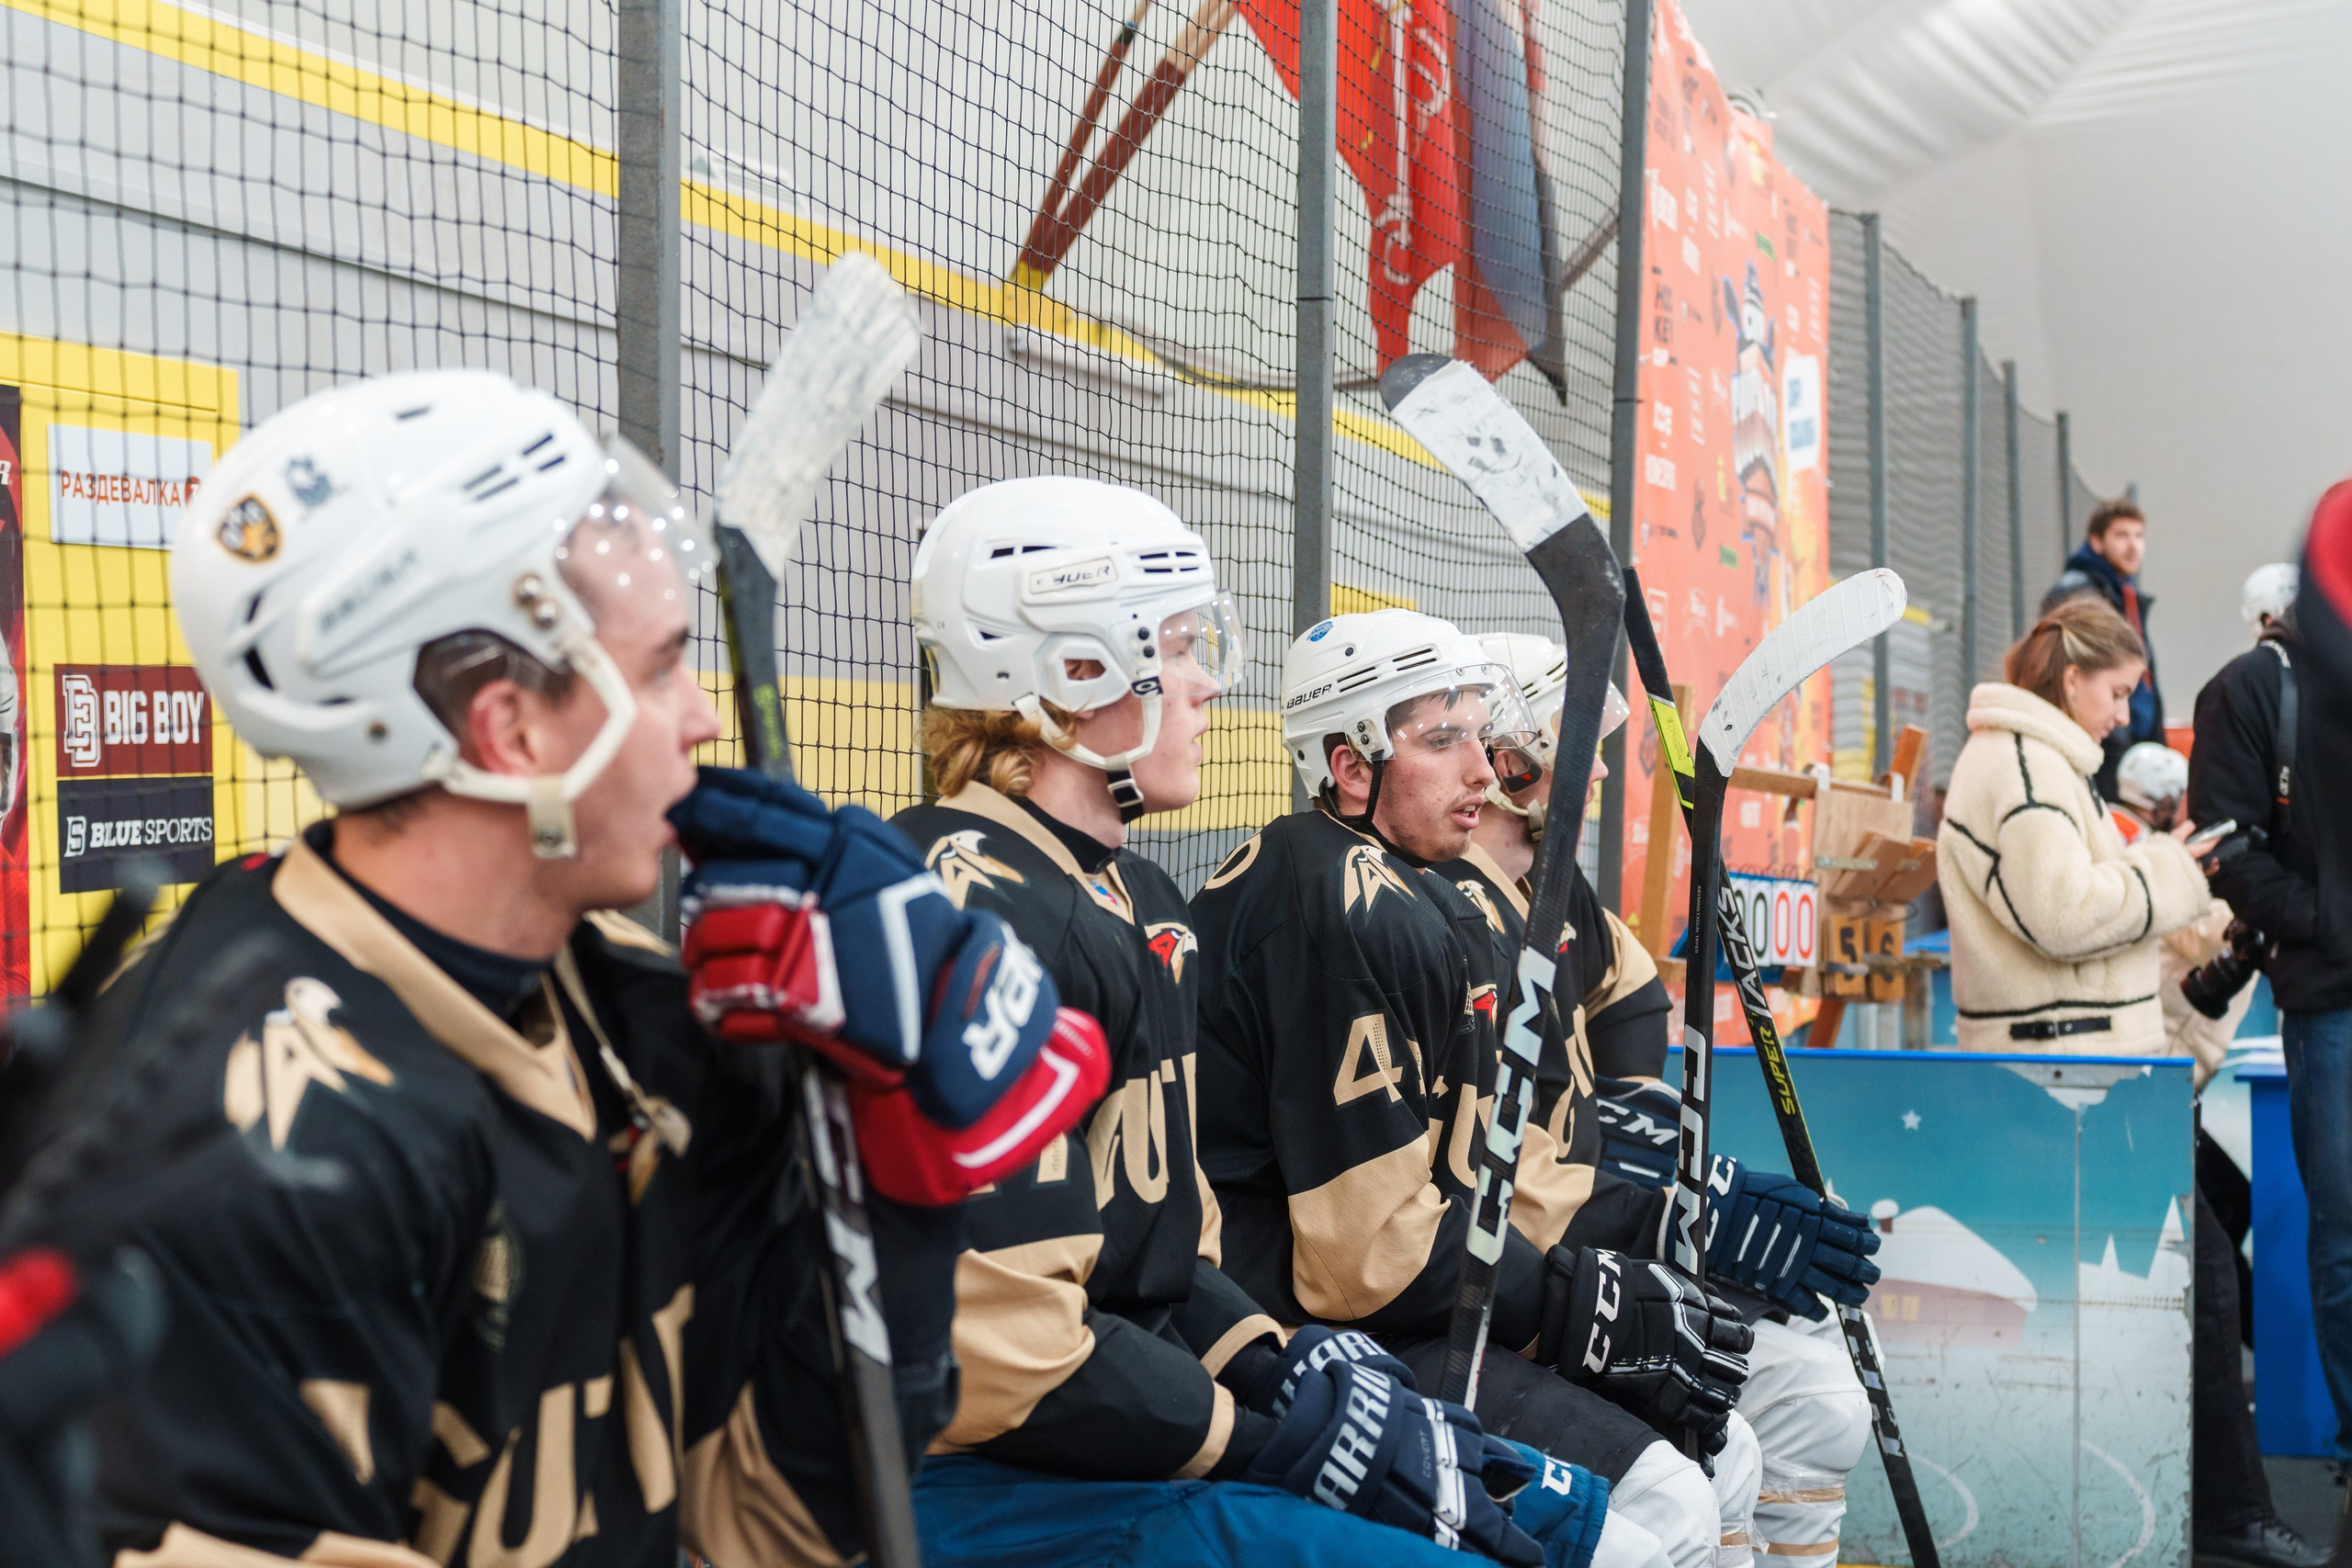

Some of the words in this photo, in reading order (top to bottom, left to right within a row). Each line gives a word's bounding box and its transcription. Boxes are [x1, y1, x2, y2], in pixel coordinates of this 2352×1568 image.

[61, 468, 182, 508] РАЗДЕВАЛКА
[103, 691, 148, 745] BIG
[153, 691, 205, 744] BOY
[1286, 683, 1332, 710] BAUER
[1717, 886, 1773, 1019] TACKS
[1466, 945, 1556, 1267] CCM
[1759, 1025, 1796, 1116] SUPER
[1674, 1023, 1707, 1276] CCM
[1582, 1247, 1622, 1374] CCM
